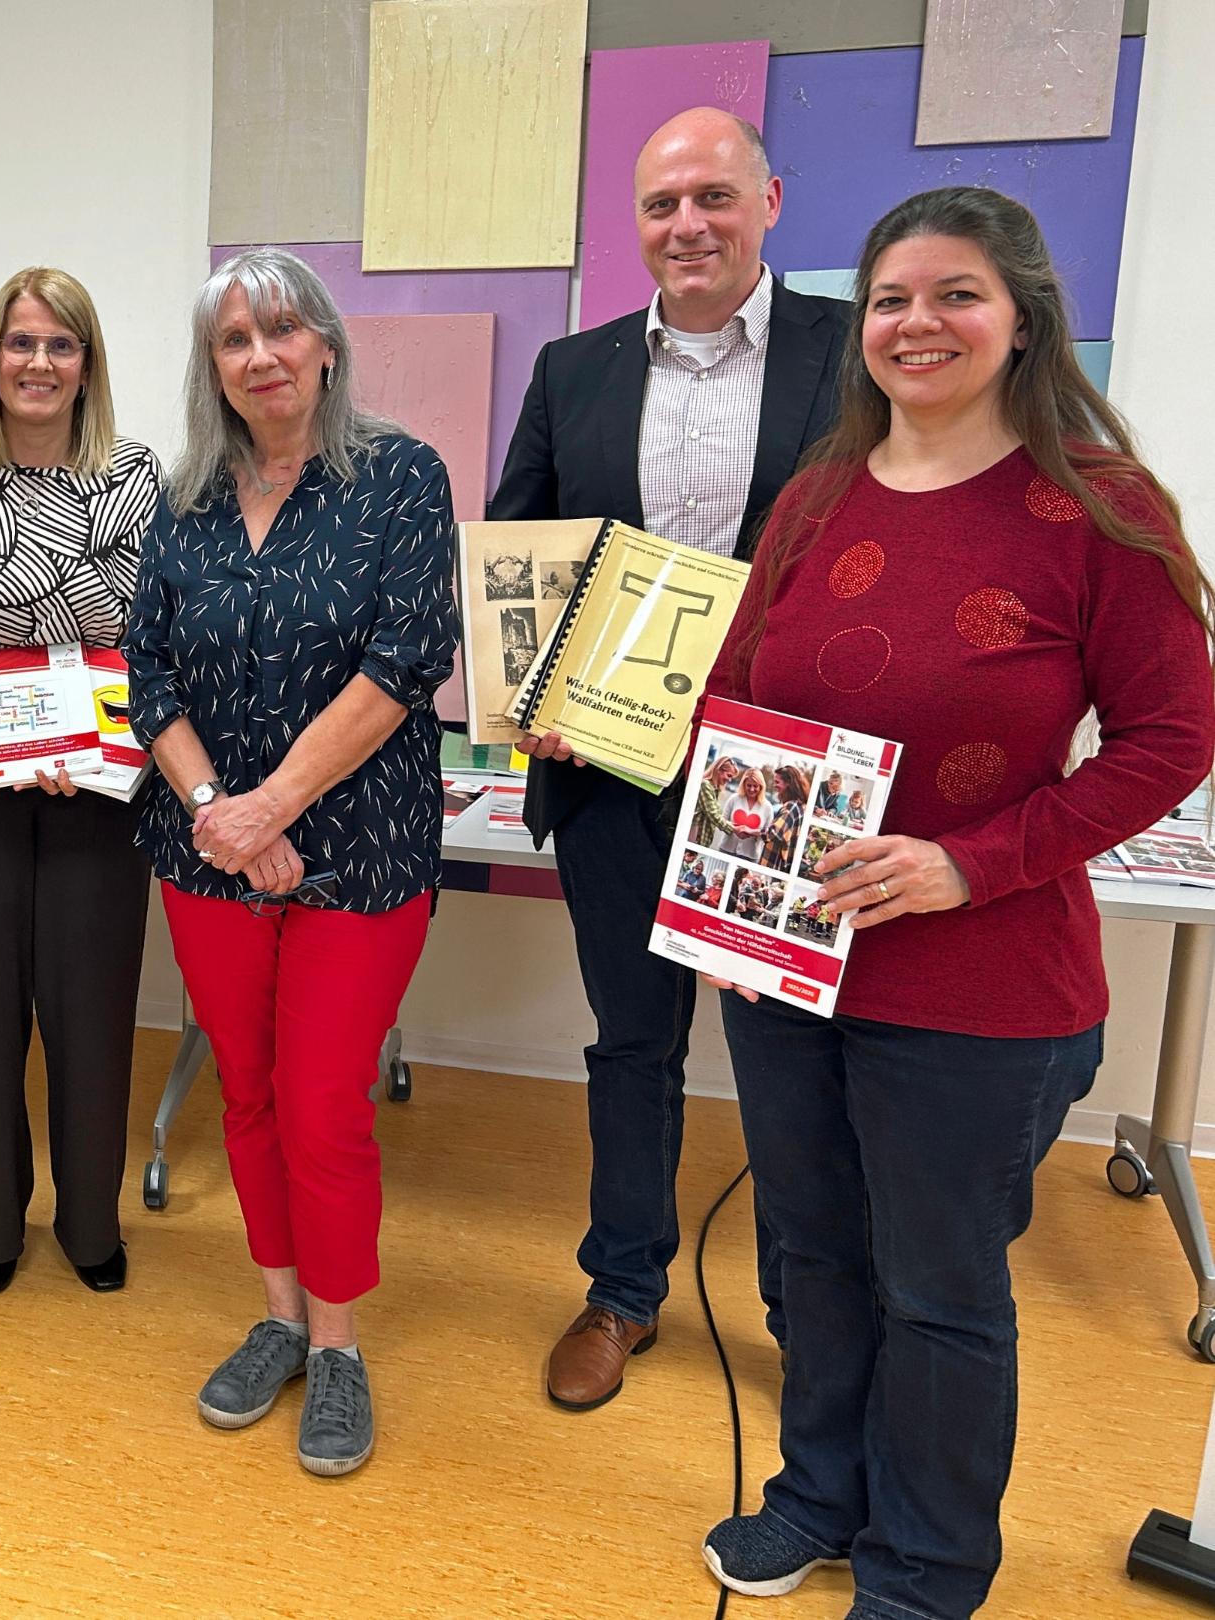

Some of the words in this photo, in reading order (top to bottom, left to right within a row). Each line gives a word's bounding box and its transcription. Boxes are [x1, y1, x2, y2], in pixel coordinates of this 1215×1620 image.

[565, 676, 584, 690] Wie
[587, 684, 603, 698] ich
[604, 690, 676, 722] (Heilig-Rock)-
[567, 690, 627, 718] Wallfahrten
[625, 714, 665, 732] erlebte!
[837, 745, 865, 758] BILDUNG
[853, 758, 874, 768] LEBEN
[703, 926, 736, 941] Geschichten
[736, 937, 747, 945] der
[746, 941, 793, 961] Hilfsbereitschaft
